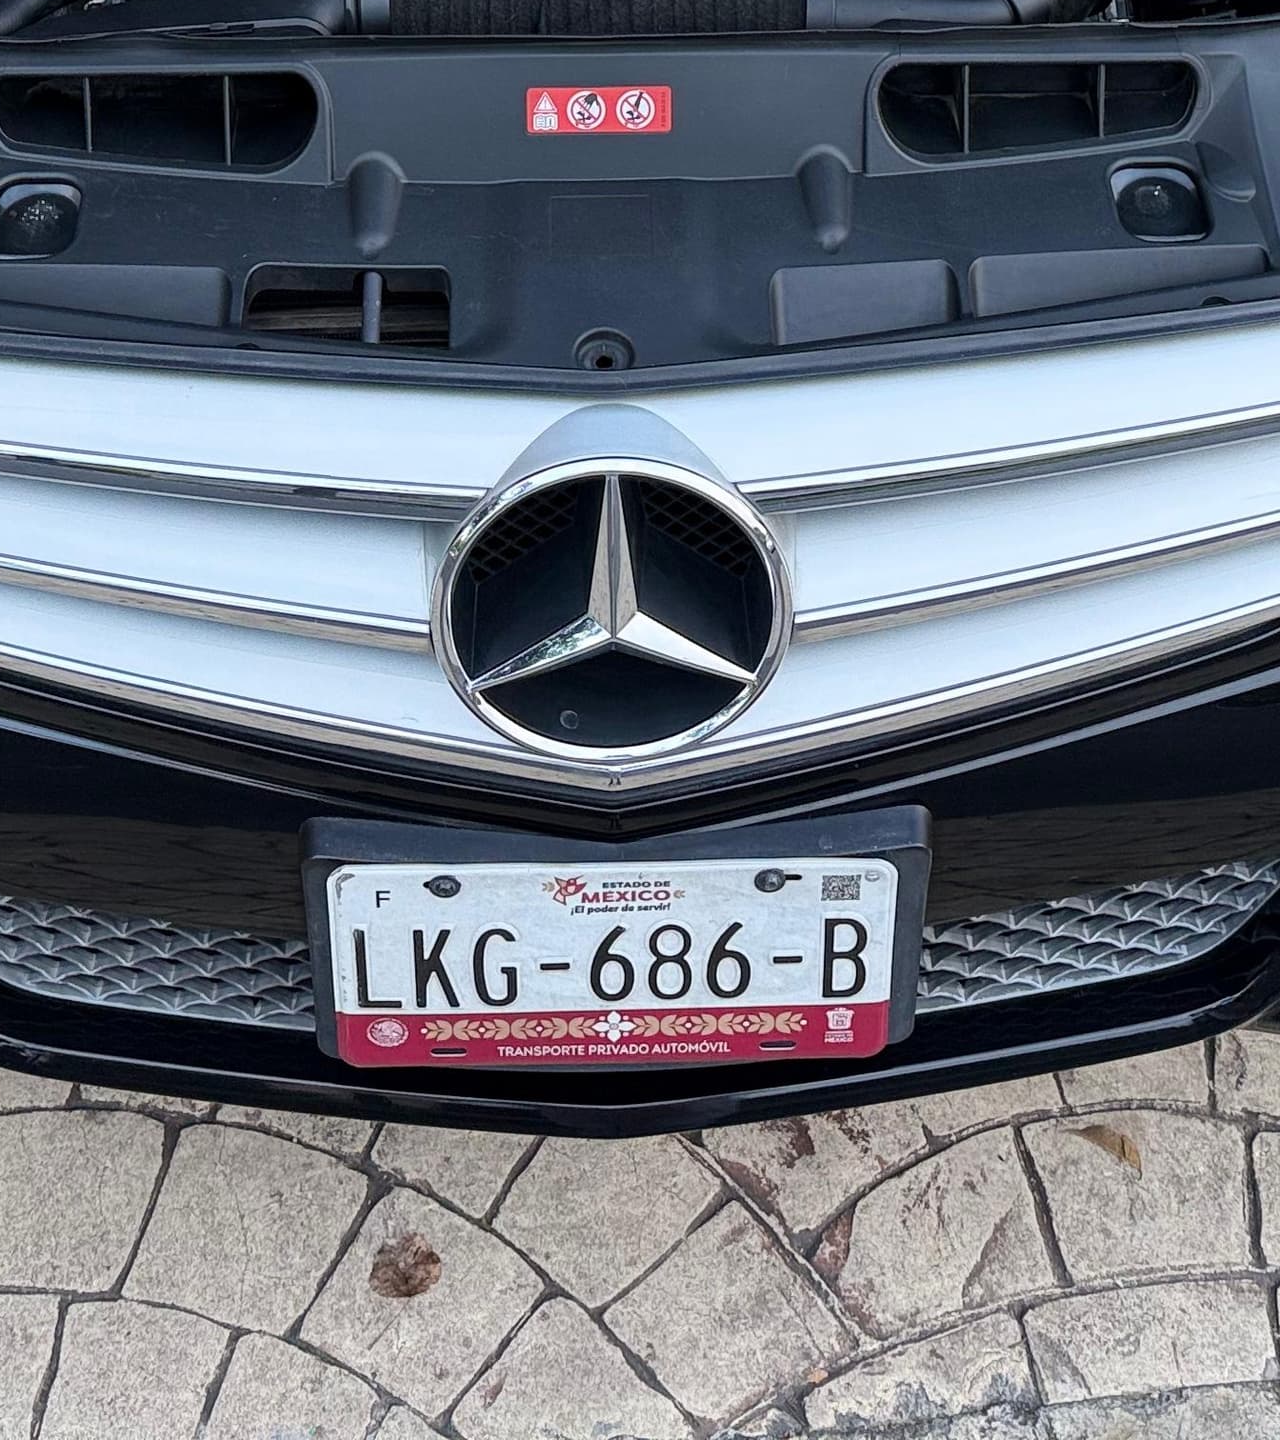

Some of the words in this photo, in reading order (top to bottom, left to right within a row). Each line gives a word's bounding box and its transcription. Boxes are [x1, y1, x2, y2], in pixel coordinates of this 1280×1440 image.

[375, 890, 391, 908] F
[587, 905, 618, 915] poder
[353, 917, 869, 1009] LKG-686-B
[497, 1045, 585, 1057] TRANSPORTE
[588, 1044, 649, 1055] PRIVADO
[651, 1040, 731, 1054] AUTOMÓVIL
